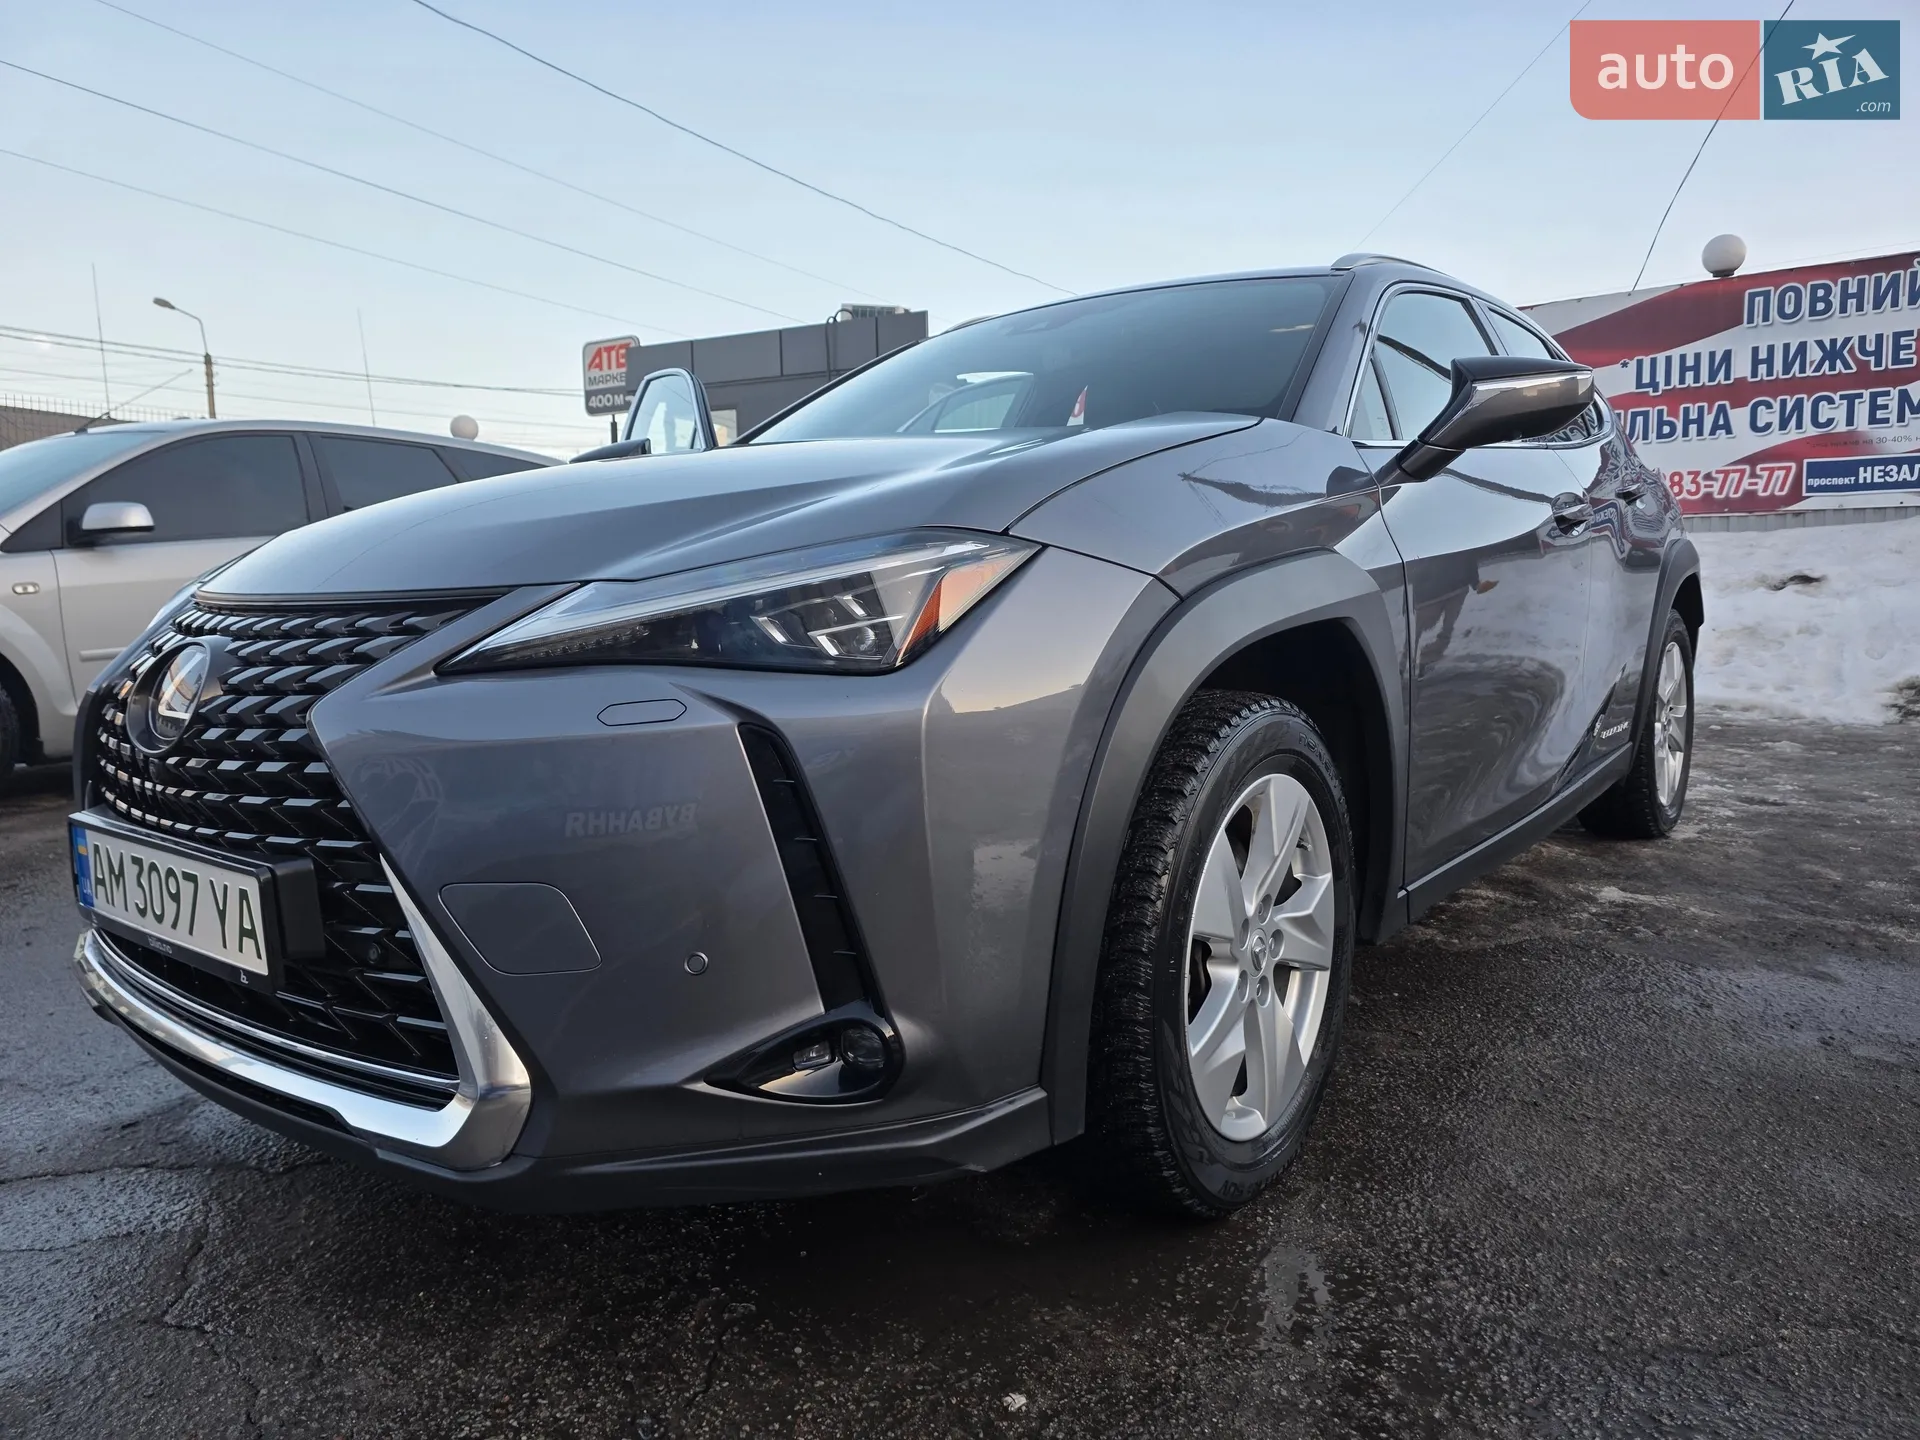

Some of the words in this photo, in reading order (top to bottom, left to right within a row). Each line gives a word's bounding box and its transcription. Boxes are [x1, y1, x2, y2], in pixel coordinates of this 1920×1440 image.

[1750, 329, 1915, 380] НИЖЧЕ
[588, 372, 626, 386] МАРКЕ
[1615, 402, 1734, 442] ЛЬНА
[1875, 435, 1912, 444] 30-40%
[1662, 465, 1793, 497] 83-77-77
[1807, 476, 1856, 487] проспект
[82, 876, 93, 897] UA
[93, 843, 129, 912] AM
[131, 853, 199, 937] 3097
[209, 877, 263, 961] YA
